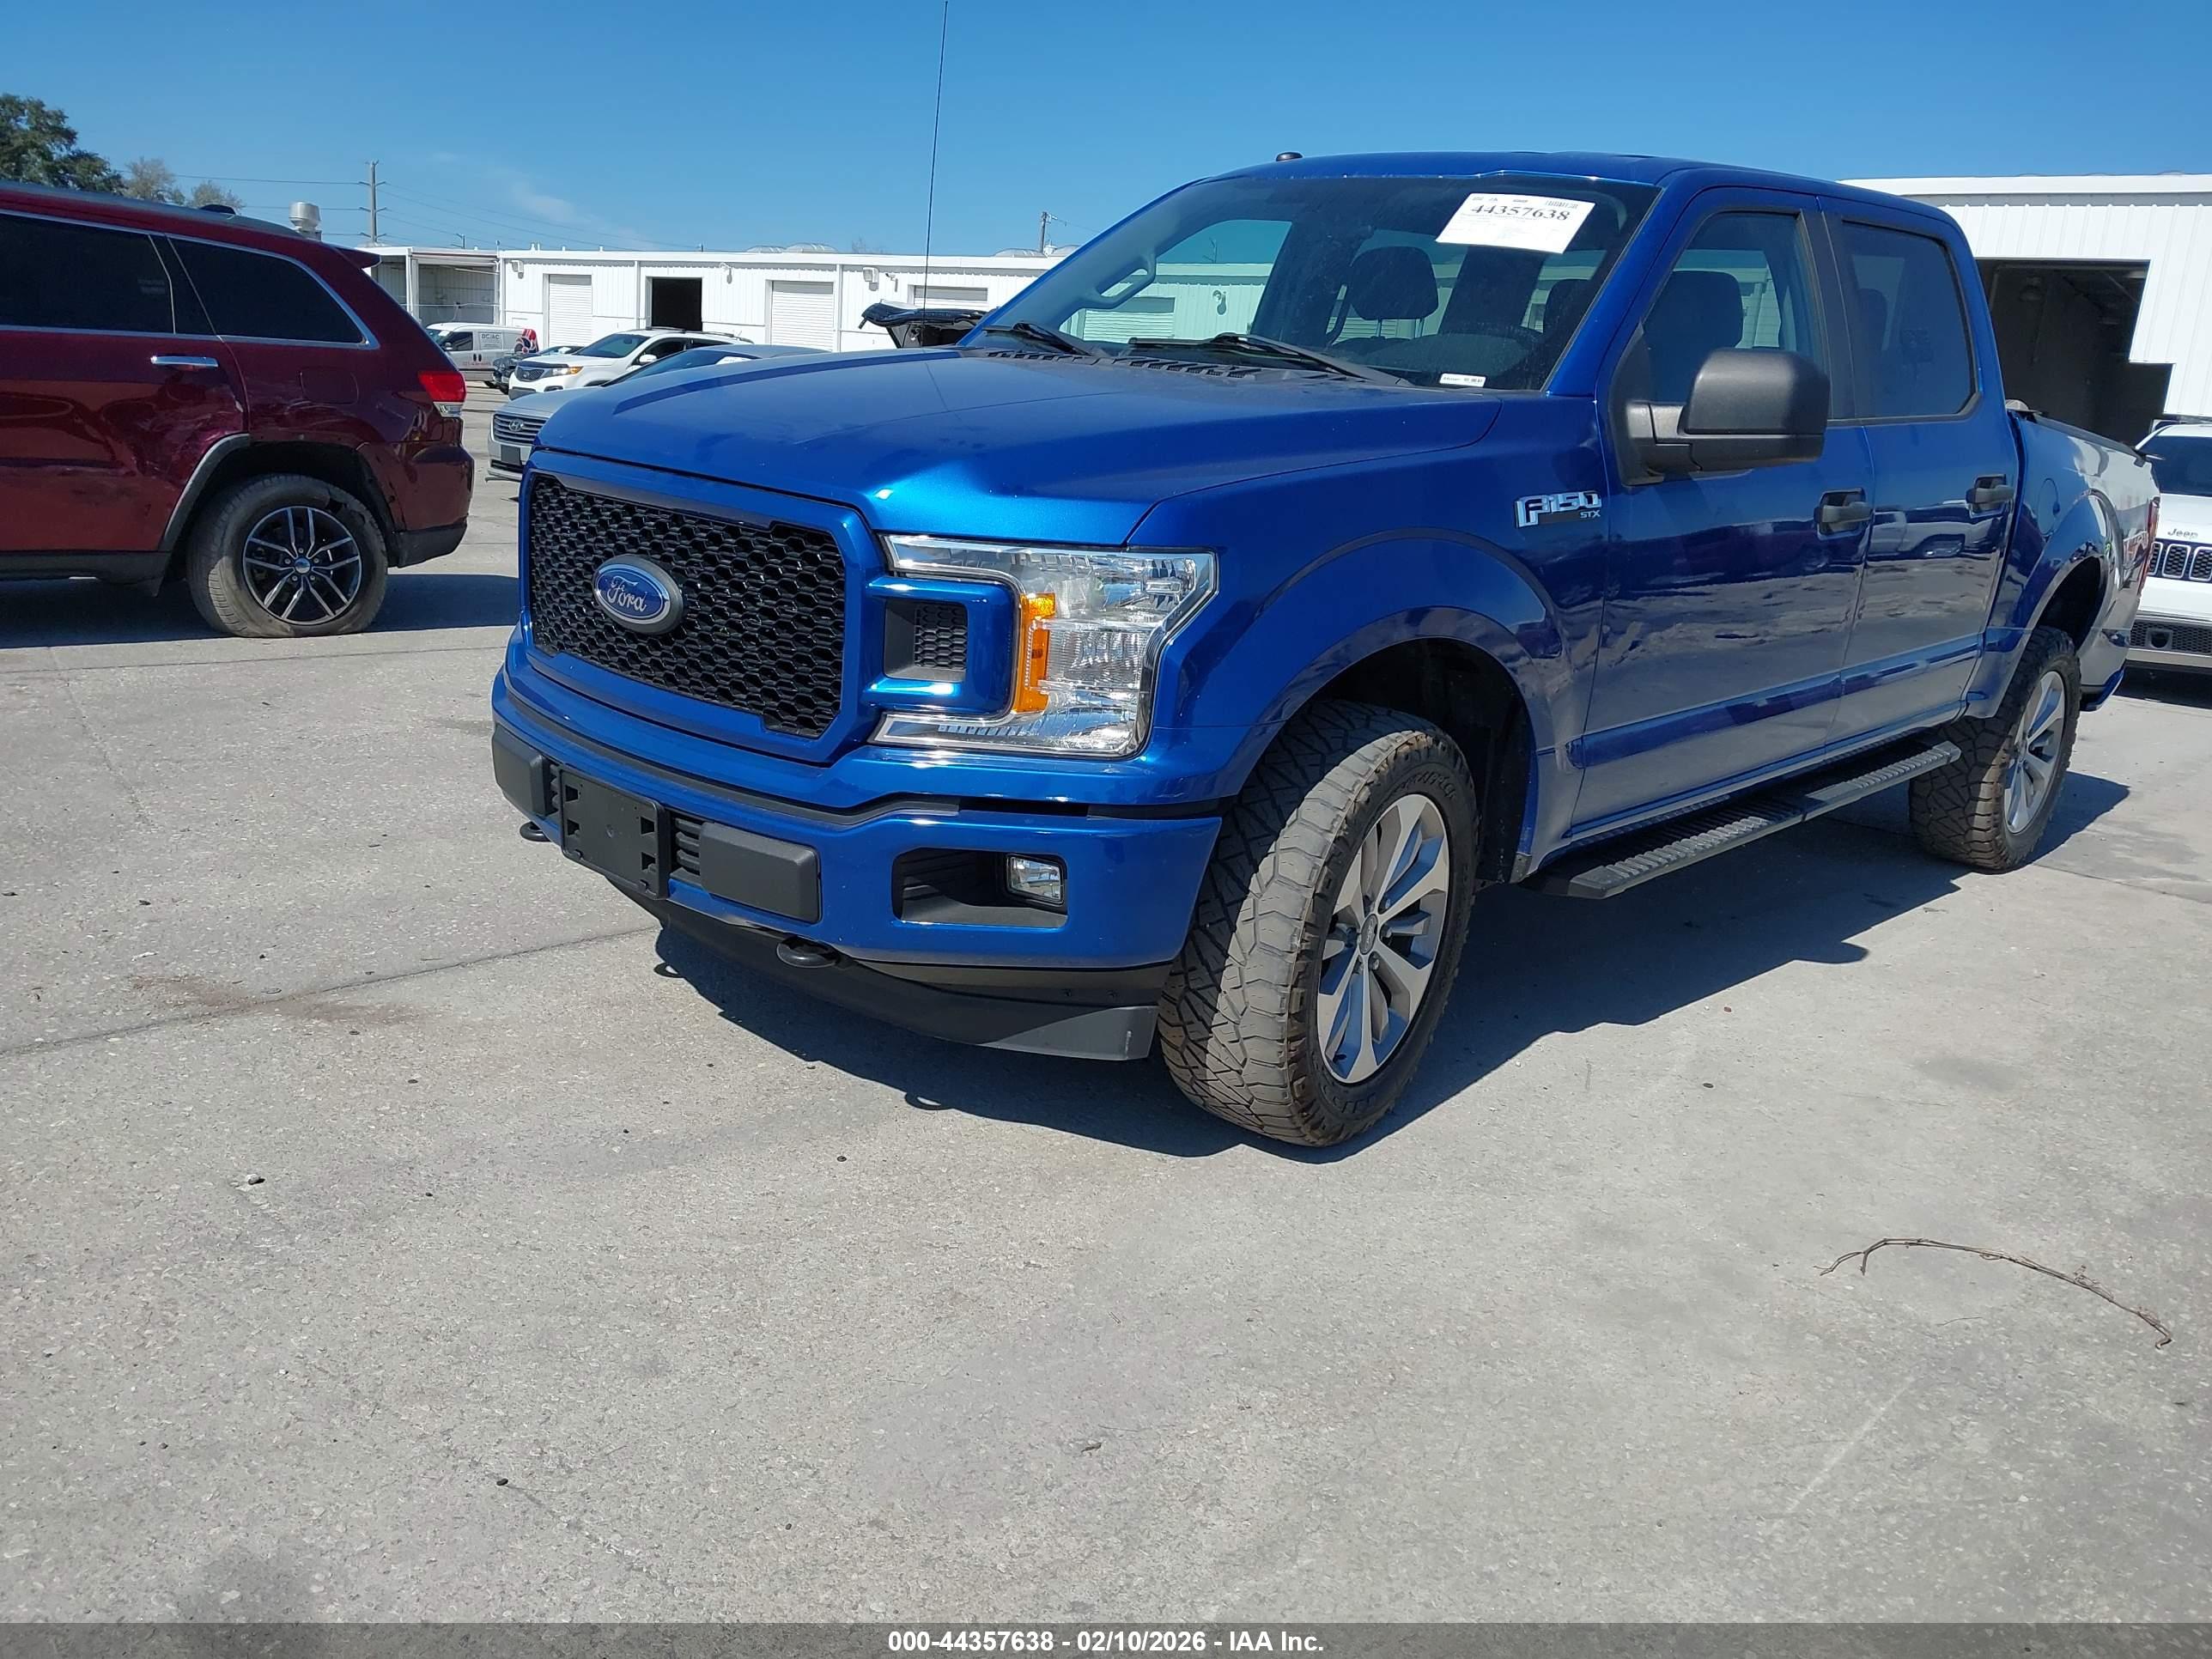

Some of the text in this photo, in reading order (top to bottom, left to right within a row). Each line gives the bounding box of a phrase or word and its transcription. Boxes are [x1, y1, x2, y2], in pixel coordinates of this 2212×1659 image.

[1470, 205, 1571, 221] 44357638
[1580, 509, 1601, 520] STX
[2167, 528, 2198, 539] Jeep
[606, 575, 648, 612] Ford
